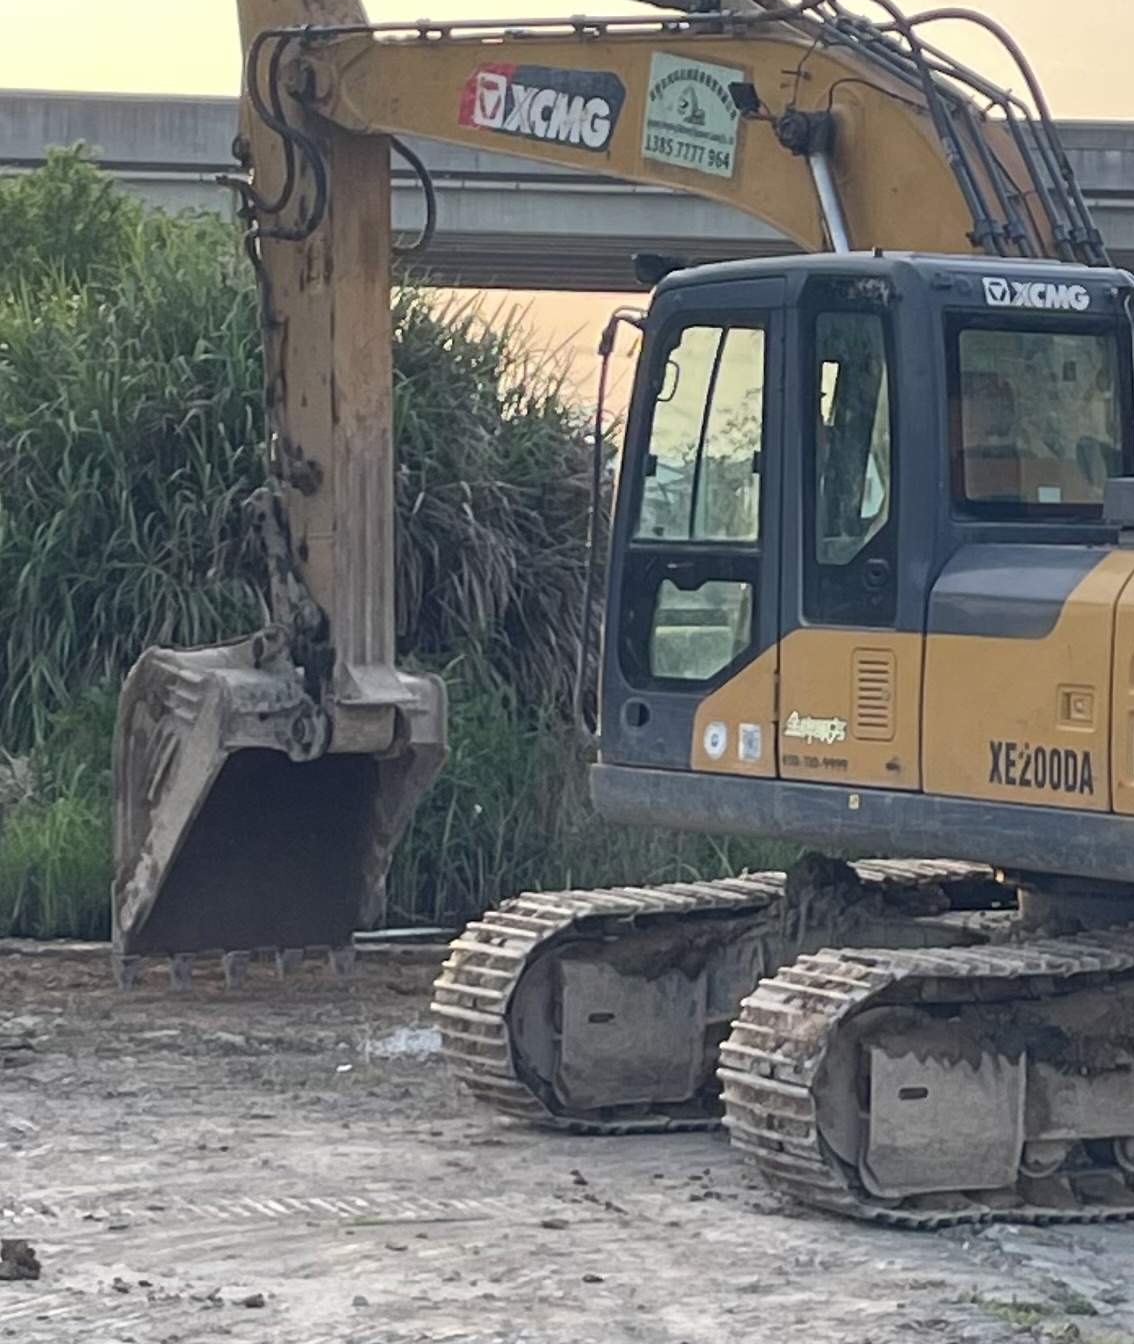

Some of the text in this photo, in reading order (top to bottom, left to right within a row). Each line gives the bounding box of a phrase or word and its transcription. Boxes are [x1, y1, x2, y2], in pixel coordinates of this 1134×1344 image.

[503, 84, 611, 148] XCMG
[1010, 281, 1090, 311] XCMG
[989, 740, 1094, 796] XE200DA
